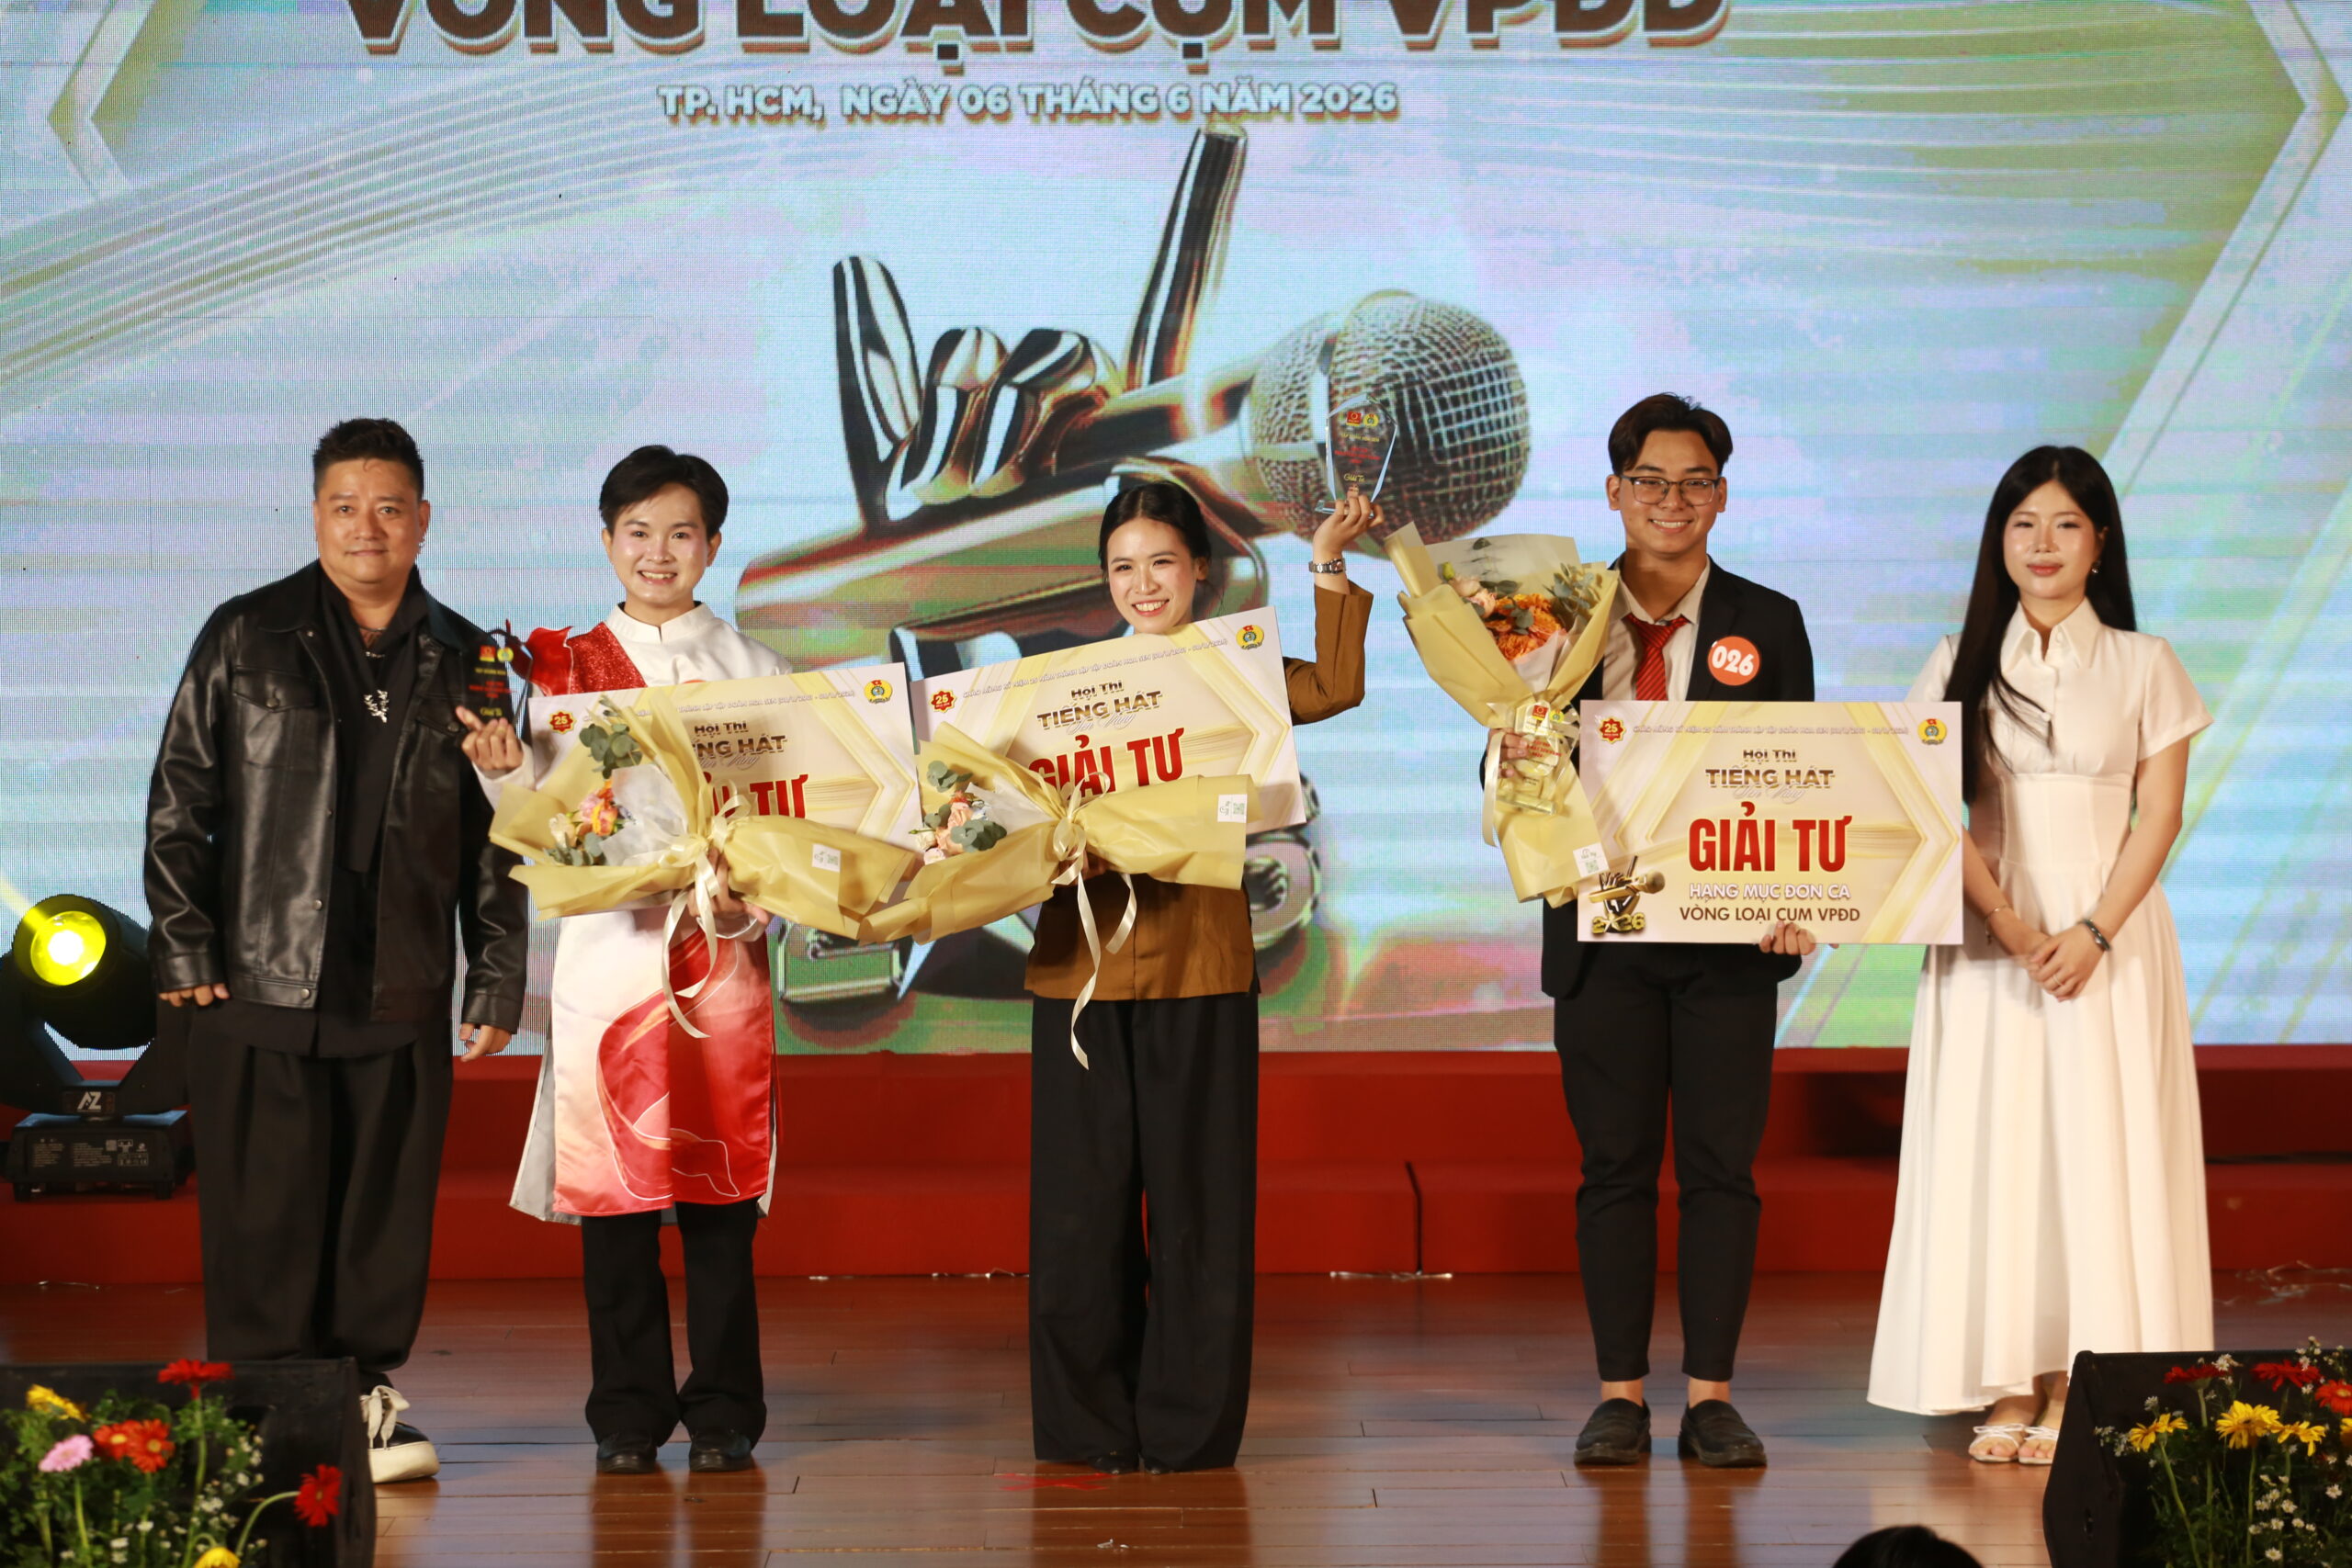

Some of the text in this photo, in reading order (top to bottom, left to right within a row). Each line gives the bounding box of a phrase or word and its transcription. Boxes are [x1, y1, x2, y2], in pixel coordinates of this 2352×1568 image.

[658, 75, 1400, 127] TP. HCM, NGÀY 06 THÁNG 6 NĂM 2026
[1712, 646, 1755, 677] 026
[935, 694, 949, 705] 25
[1070, 680, 1124, 701] Hội Thi
[1037, 690, 1162, 729] TIẾNG HÁT
[694, 721, 748, 738] Hội Thi
[1604, 723, 1618, 733] 25
[738, 733, 787, 755] HÁT
[1126, 728, 1185, 787] TƯ
[1742, 749, 1797, 764] Hội Thi
[1705, 765, 1835, 789] TIẾNG HÁT
[1689, 800, 1853, 873] GIẢI TƯ
[1689, 883, 1852, 903] HẠNG MỤC ĐƠN CA
[1679, 903, 1730, 921] VÒNG
[1735, 907, 1770, 924] LOẠI
[1817, 908, 1860, 921] VPĐD
